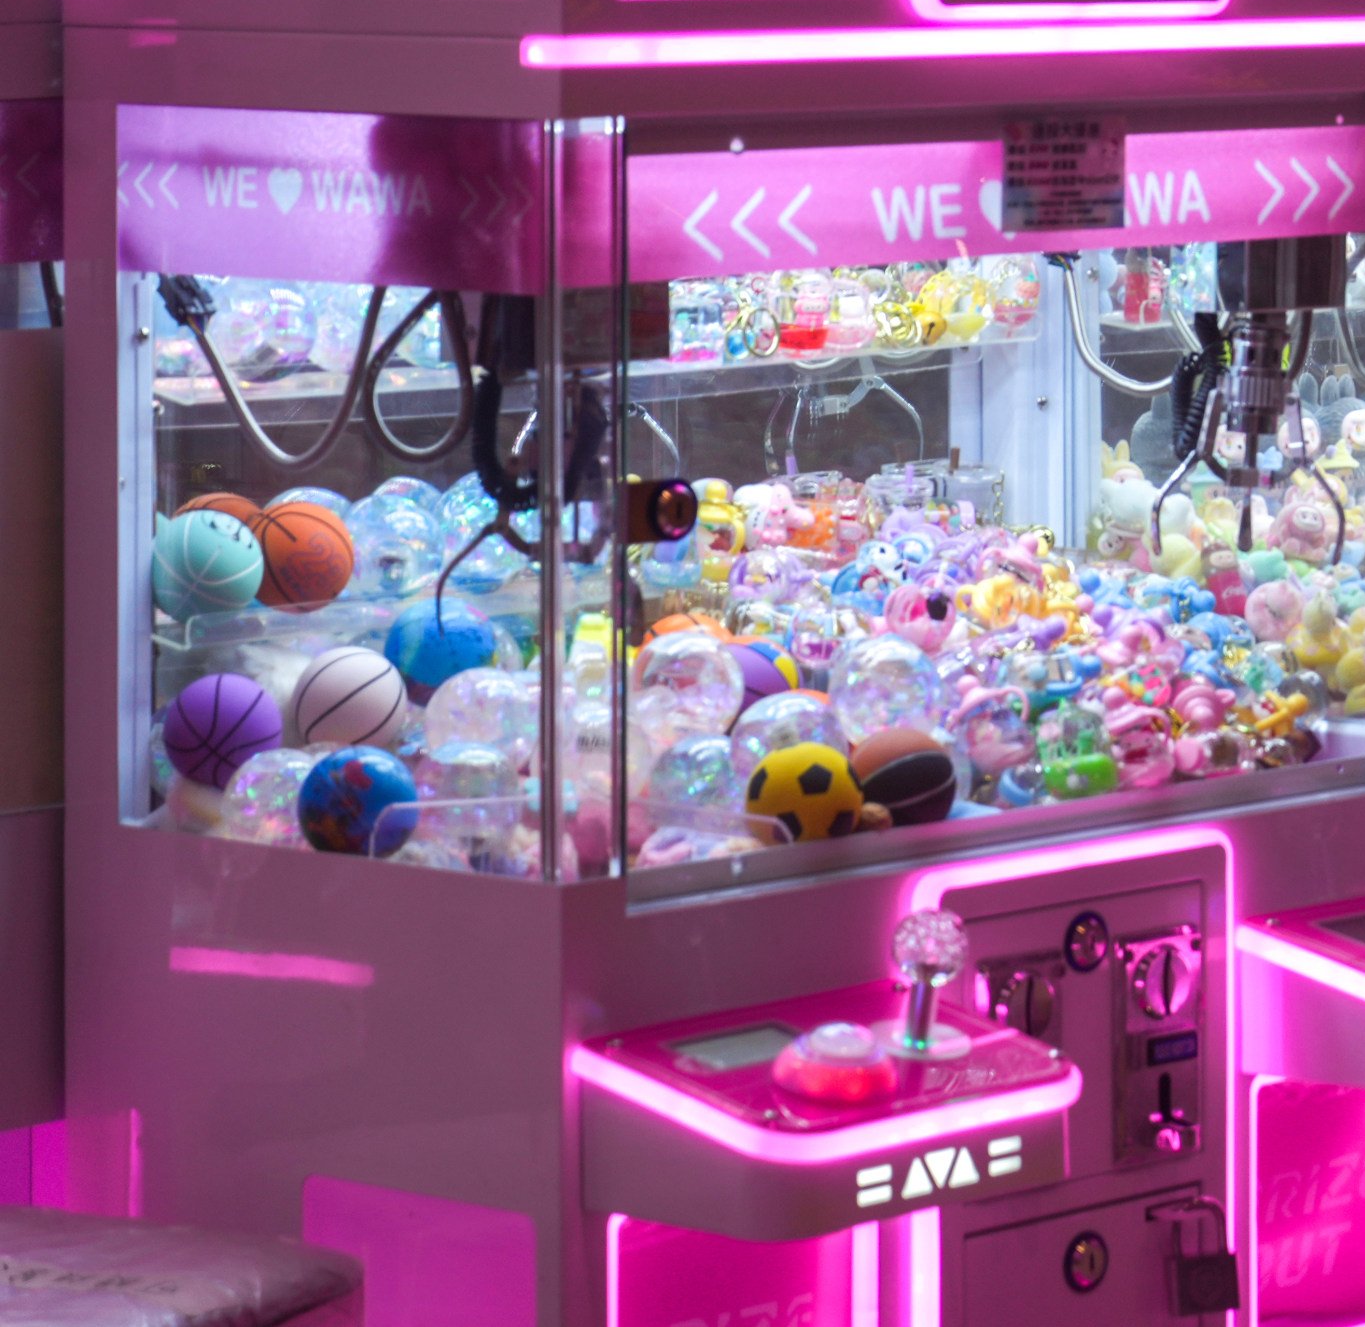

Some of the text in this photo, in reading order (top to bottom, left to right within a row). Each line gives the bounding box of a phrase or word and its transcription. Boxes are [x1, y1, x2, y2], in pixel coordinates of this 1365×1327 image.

[203, 168, 434, 217] WE WAWA
[872, 182, 968, 244] WE
[1124, 168, 1212, 226] WA
